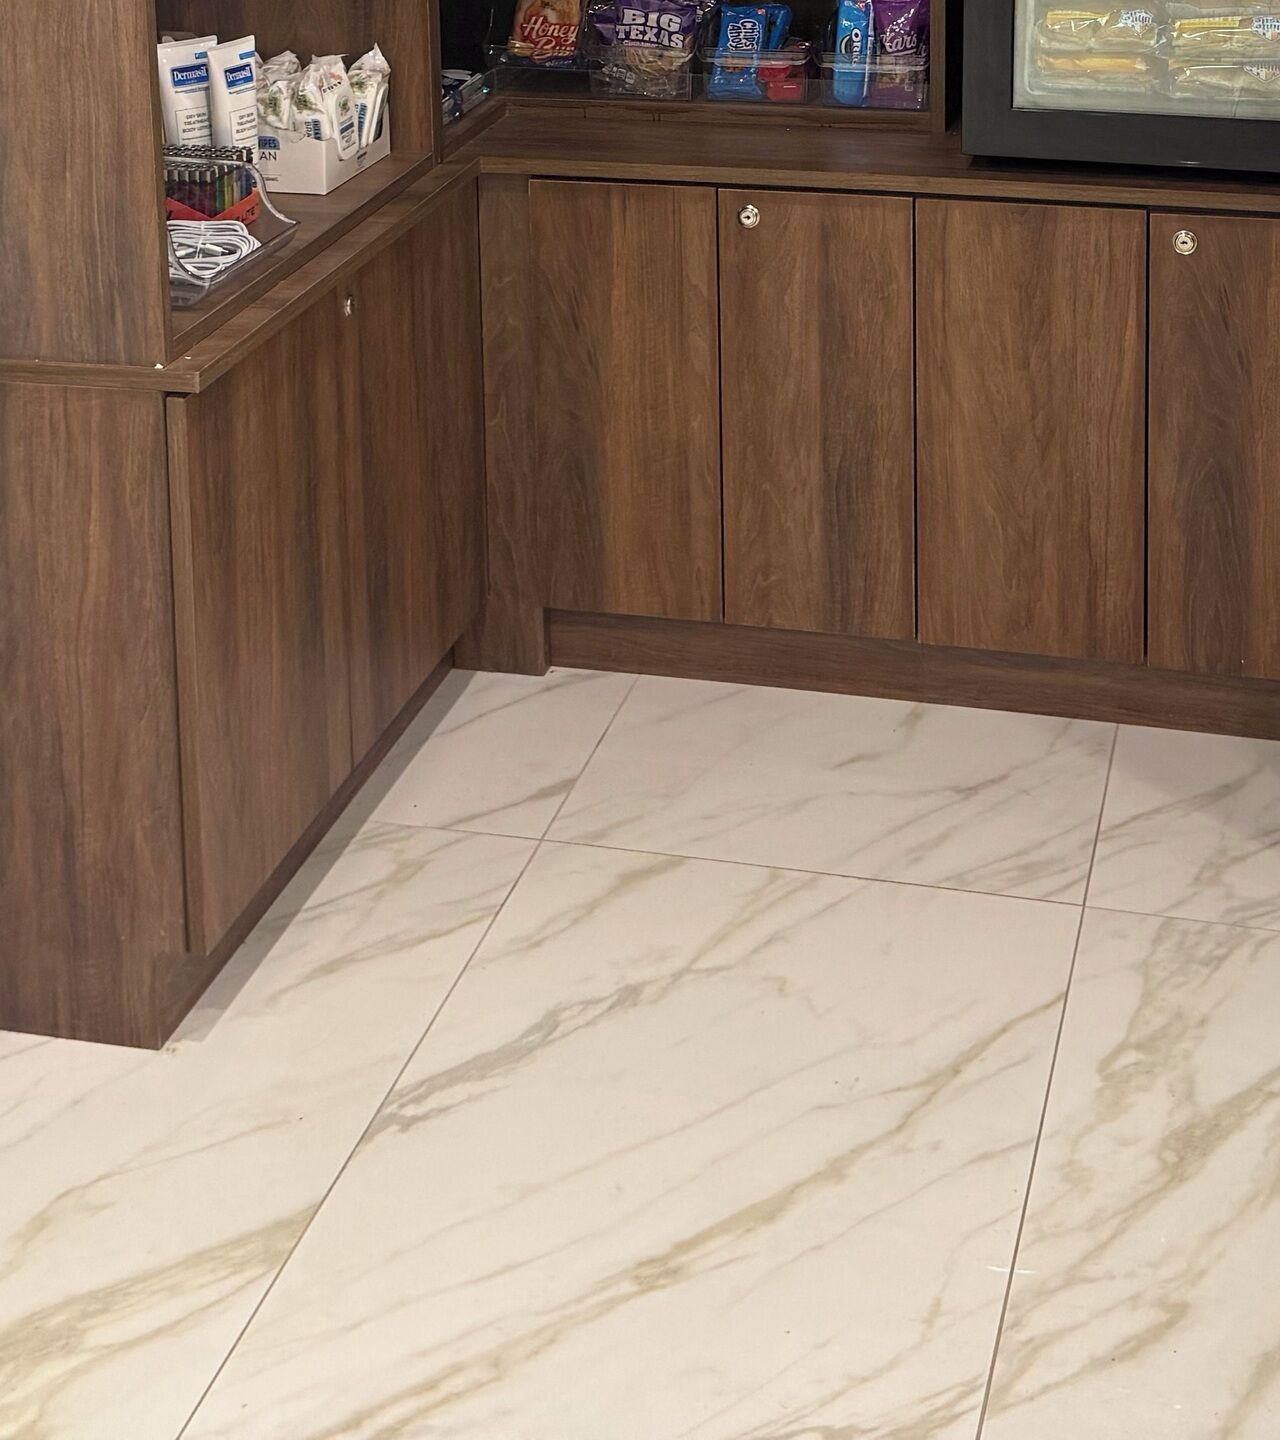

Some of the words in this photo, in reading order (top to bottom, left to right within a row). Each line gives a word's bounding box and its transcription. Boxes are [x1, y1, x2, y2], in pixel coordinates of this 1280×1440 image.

[522, 17, 579, 42] Honey
[623, 9, 681, 32] BIG
[616, 25, 684, 48] TEXAS
[740, 19, 758, 50] Chips
[226, 66, 252, 82] Dermasil
